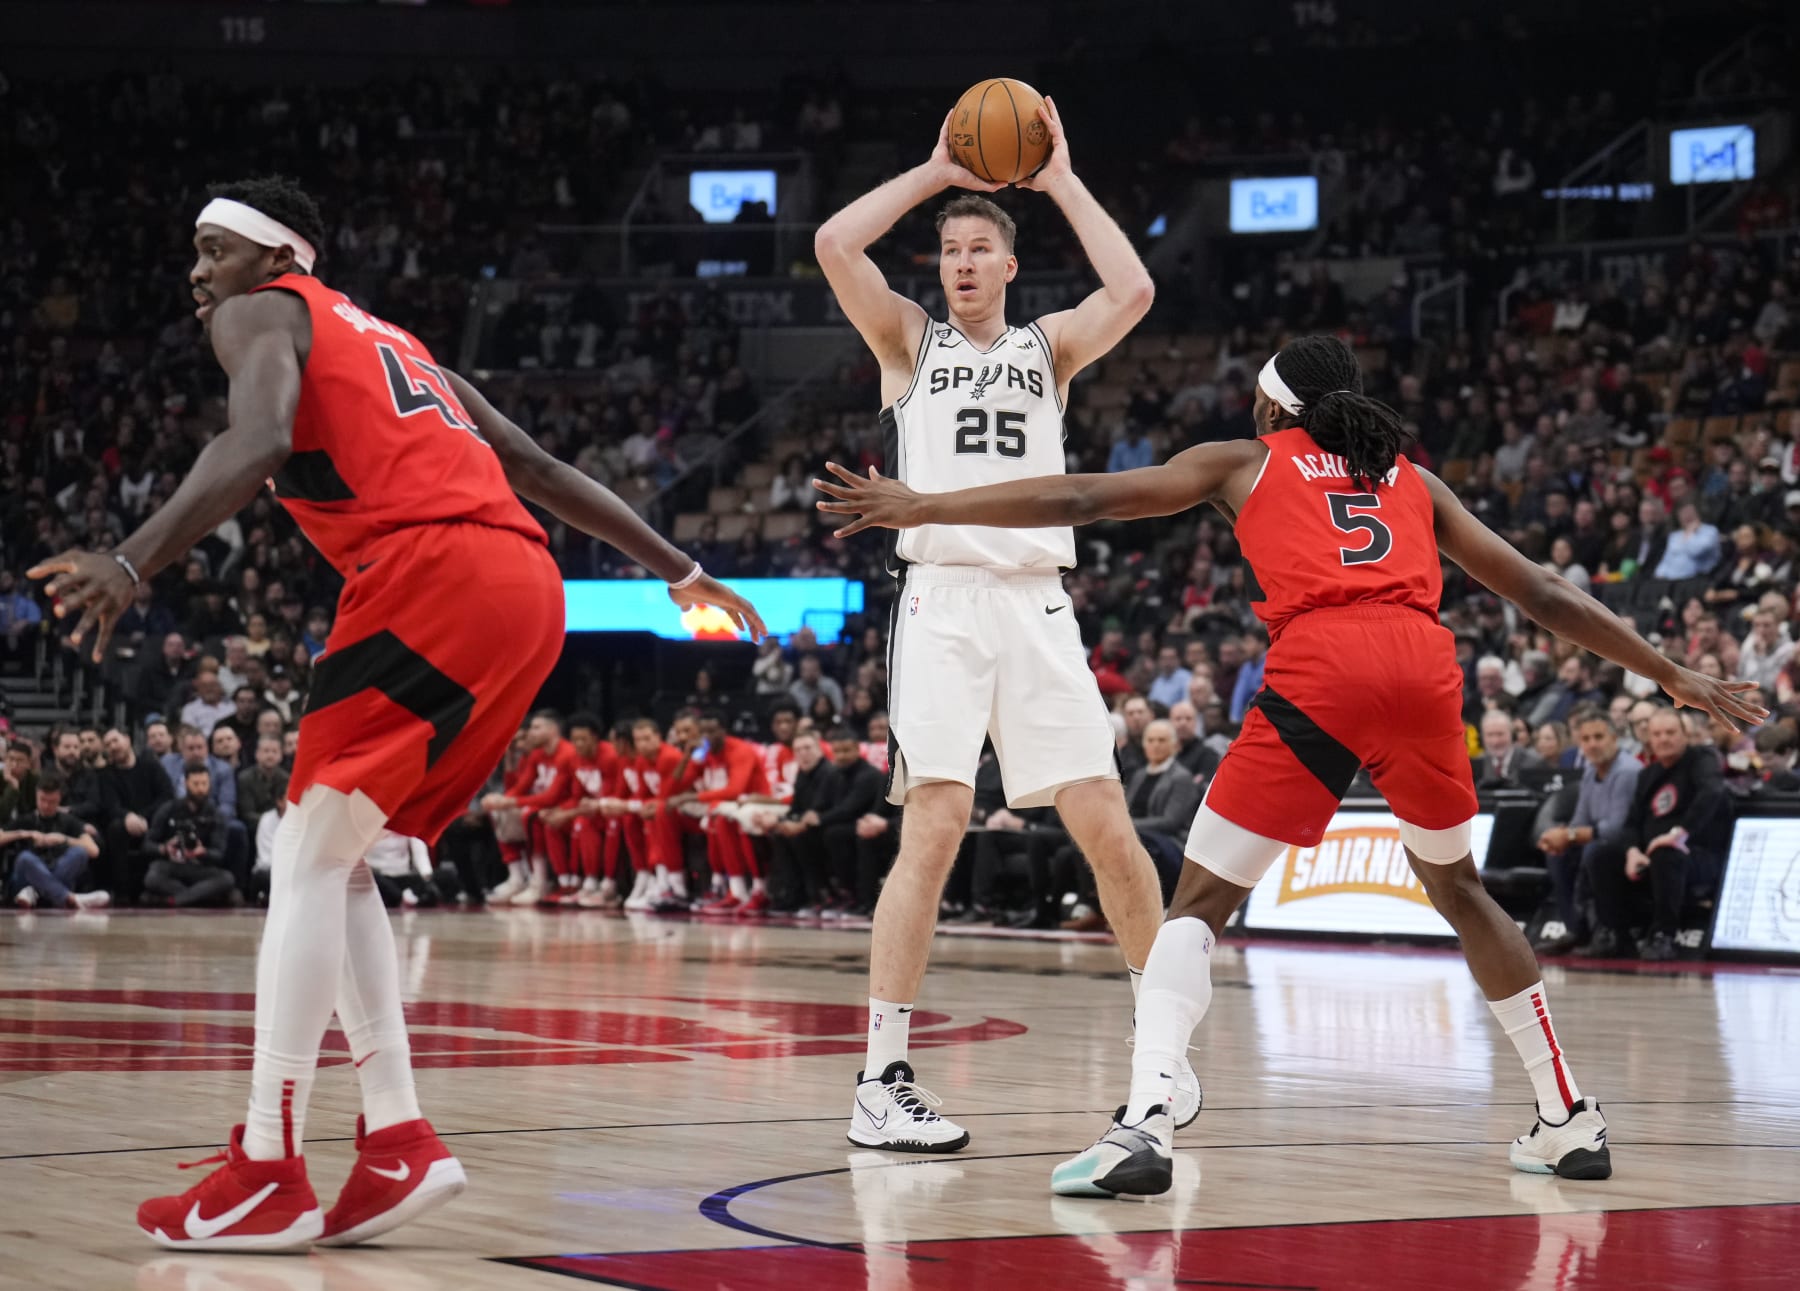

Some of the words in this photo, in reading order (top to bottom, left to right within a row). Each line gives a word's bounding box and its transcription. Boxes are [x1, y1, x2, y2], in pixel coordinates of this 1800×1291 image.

[220, 16, 265, 42] 115
[1689, 139, 1737, 172] Bell
[1250, 190, 1298, 219] Bell
[930, 363, 1044, 400] SPURS
[954, 406, 1027, 459] 25
[1291, 453, 1400, 487] ACHIA
[1325, 492, 1393, 566] 5
[1290, 836, 1427, 894] SMIRNO
